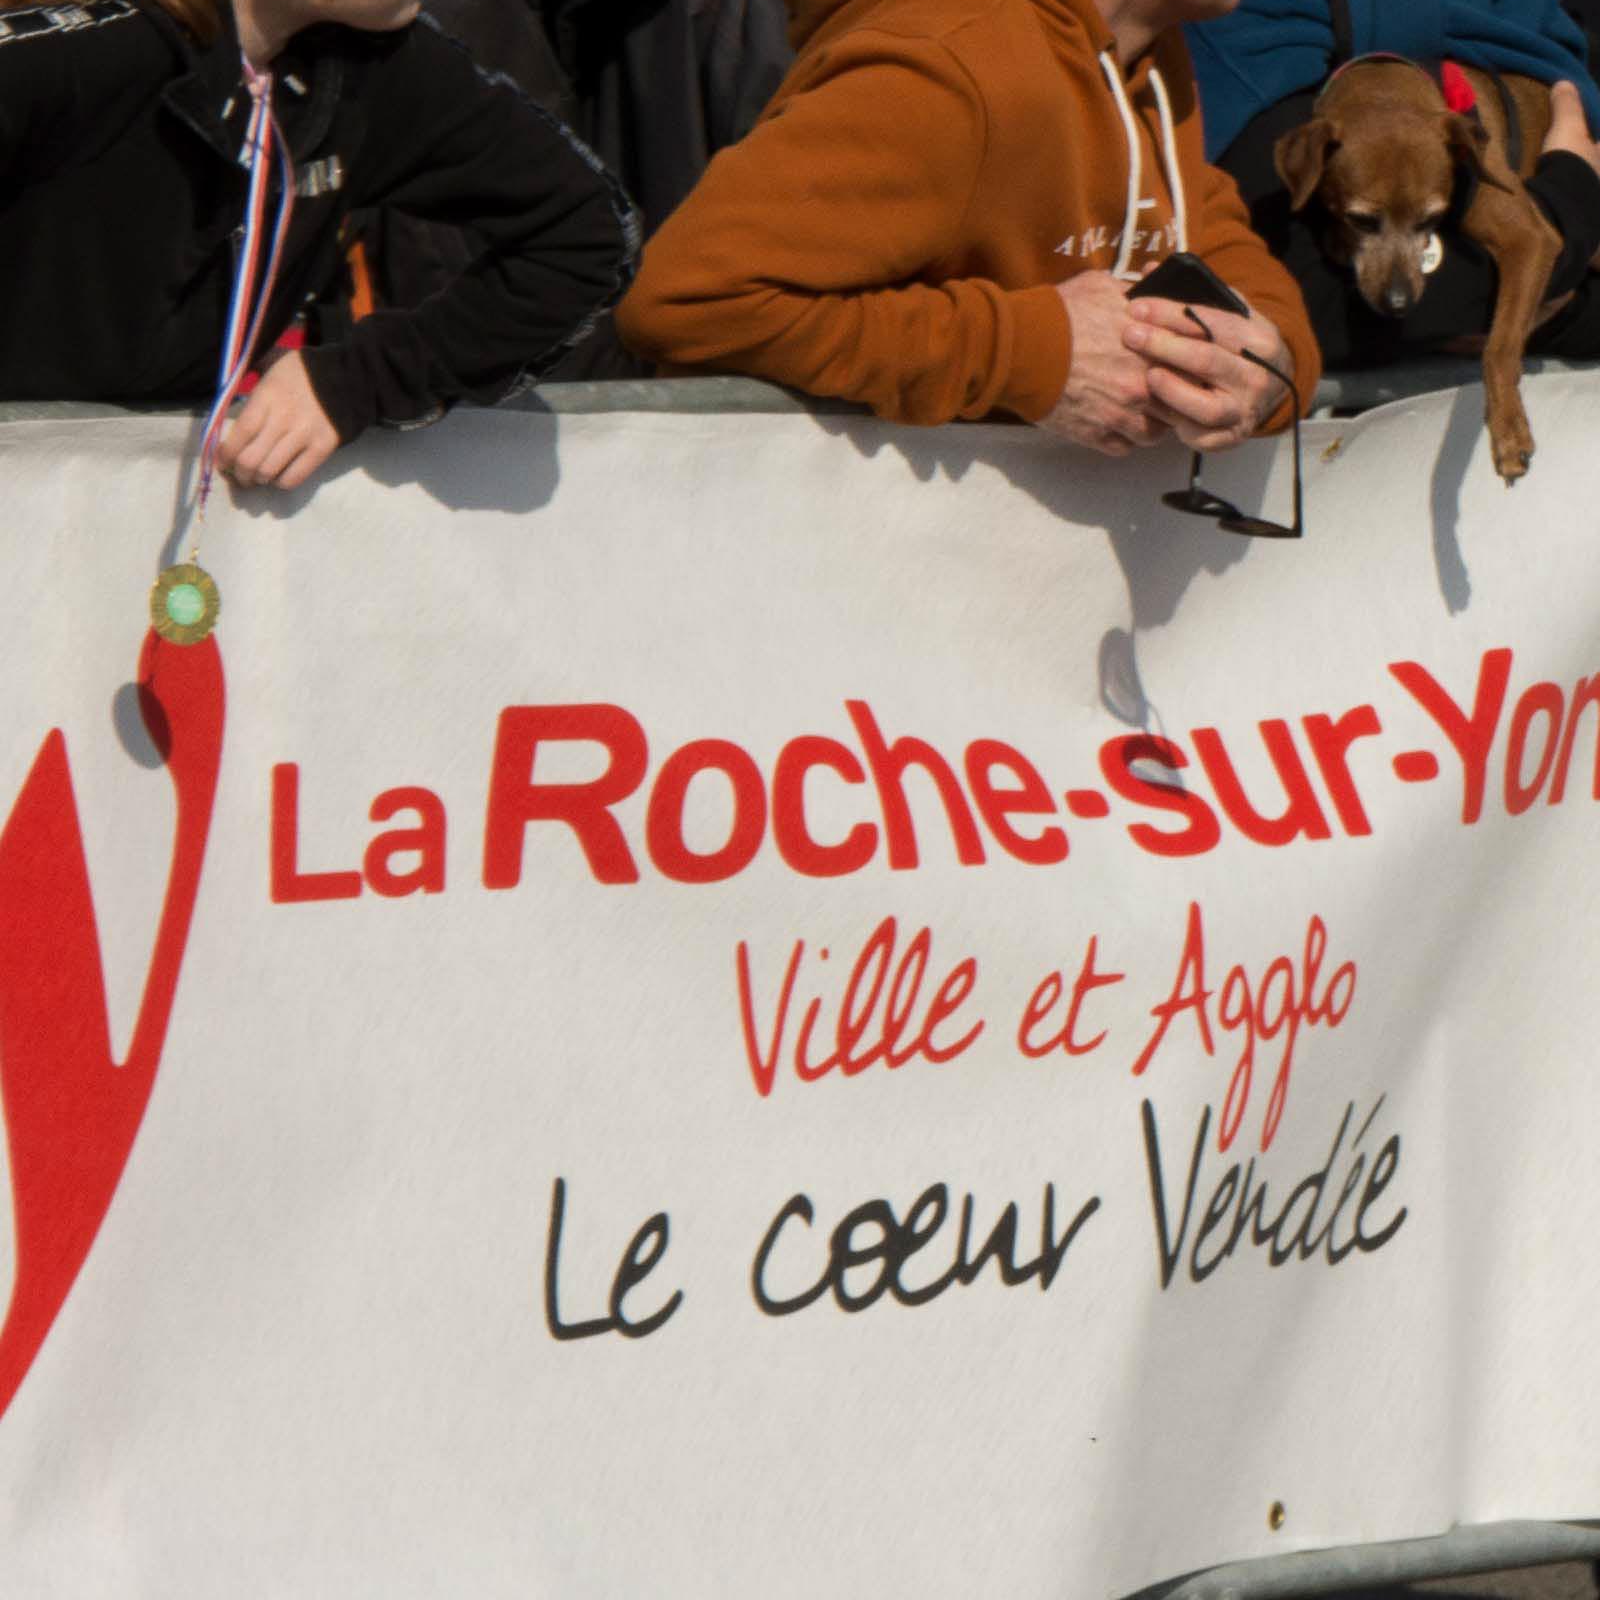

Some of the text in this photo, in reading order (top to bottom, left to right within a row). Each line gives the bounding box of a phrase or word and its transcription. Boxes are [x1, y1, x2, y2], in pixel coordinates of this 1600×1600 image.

[269, 760, 447, 905] La
[736, 900, 1357, 1153] Ville et Agglo
[544, 1176, 684, 1341] Le
[1141, 1093, 1408, 1291] Vendée
